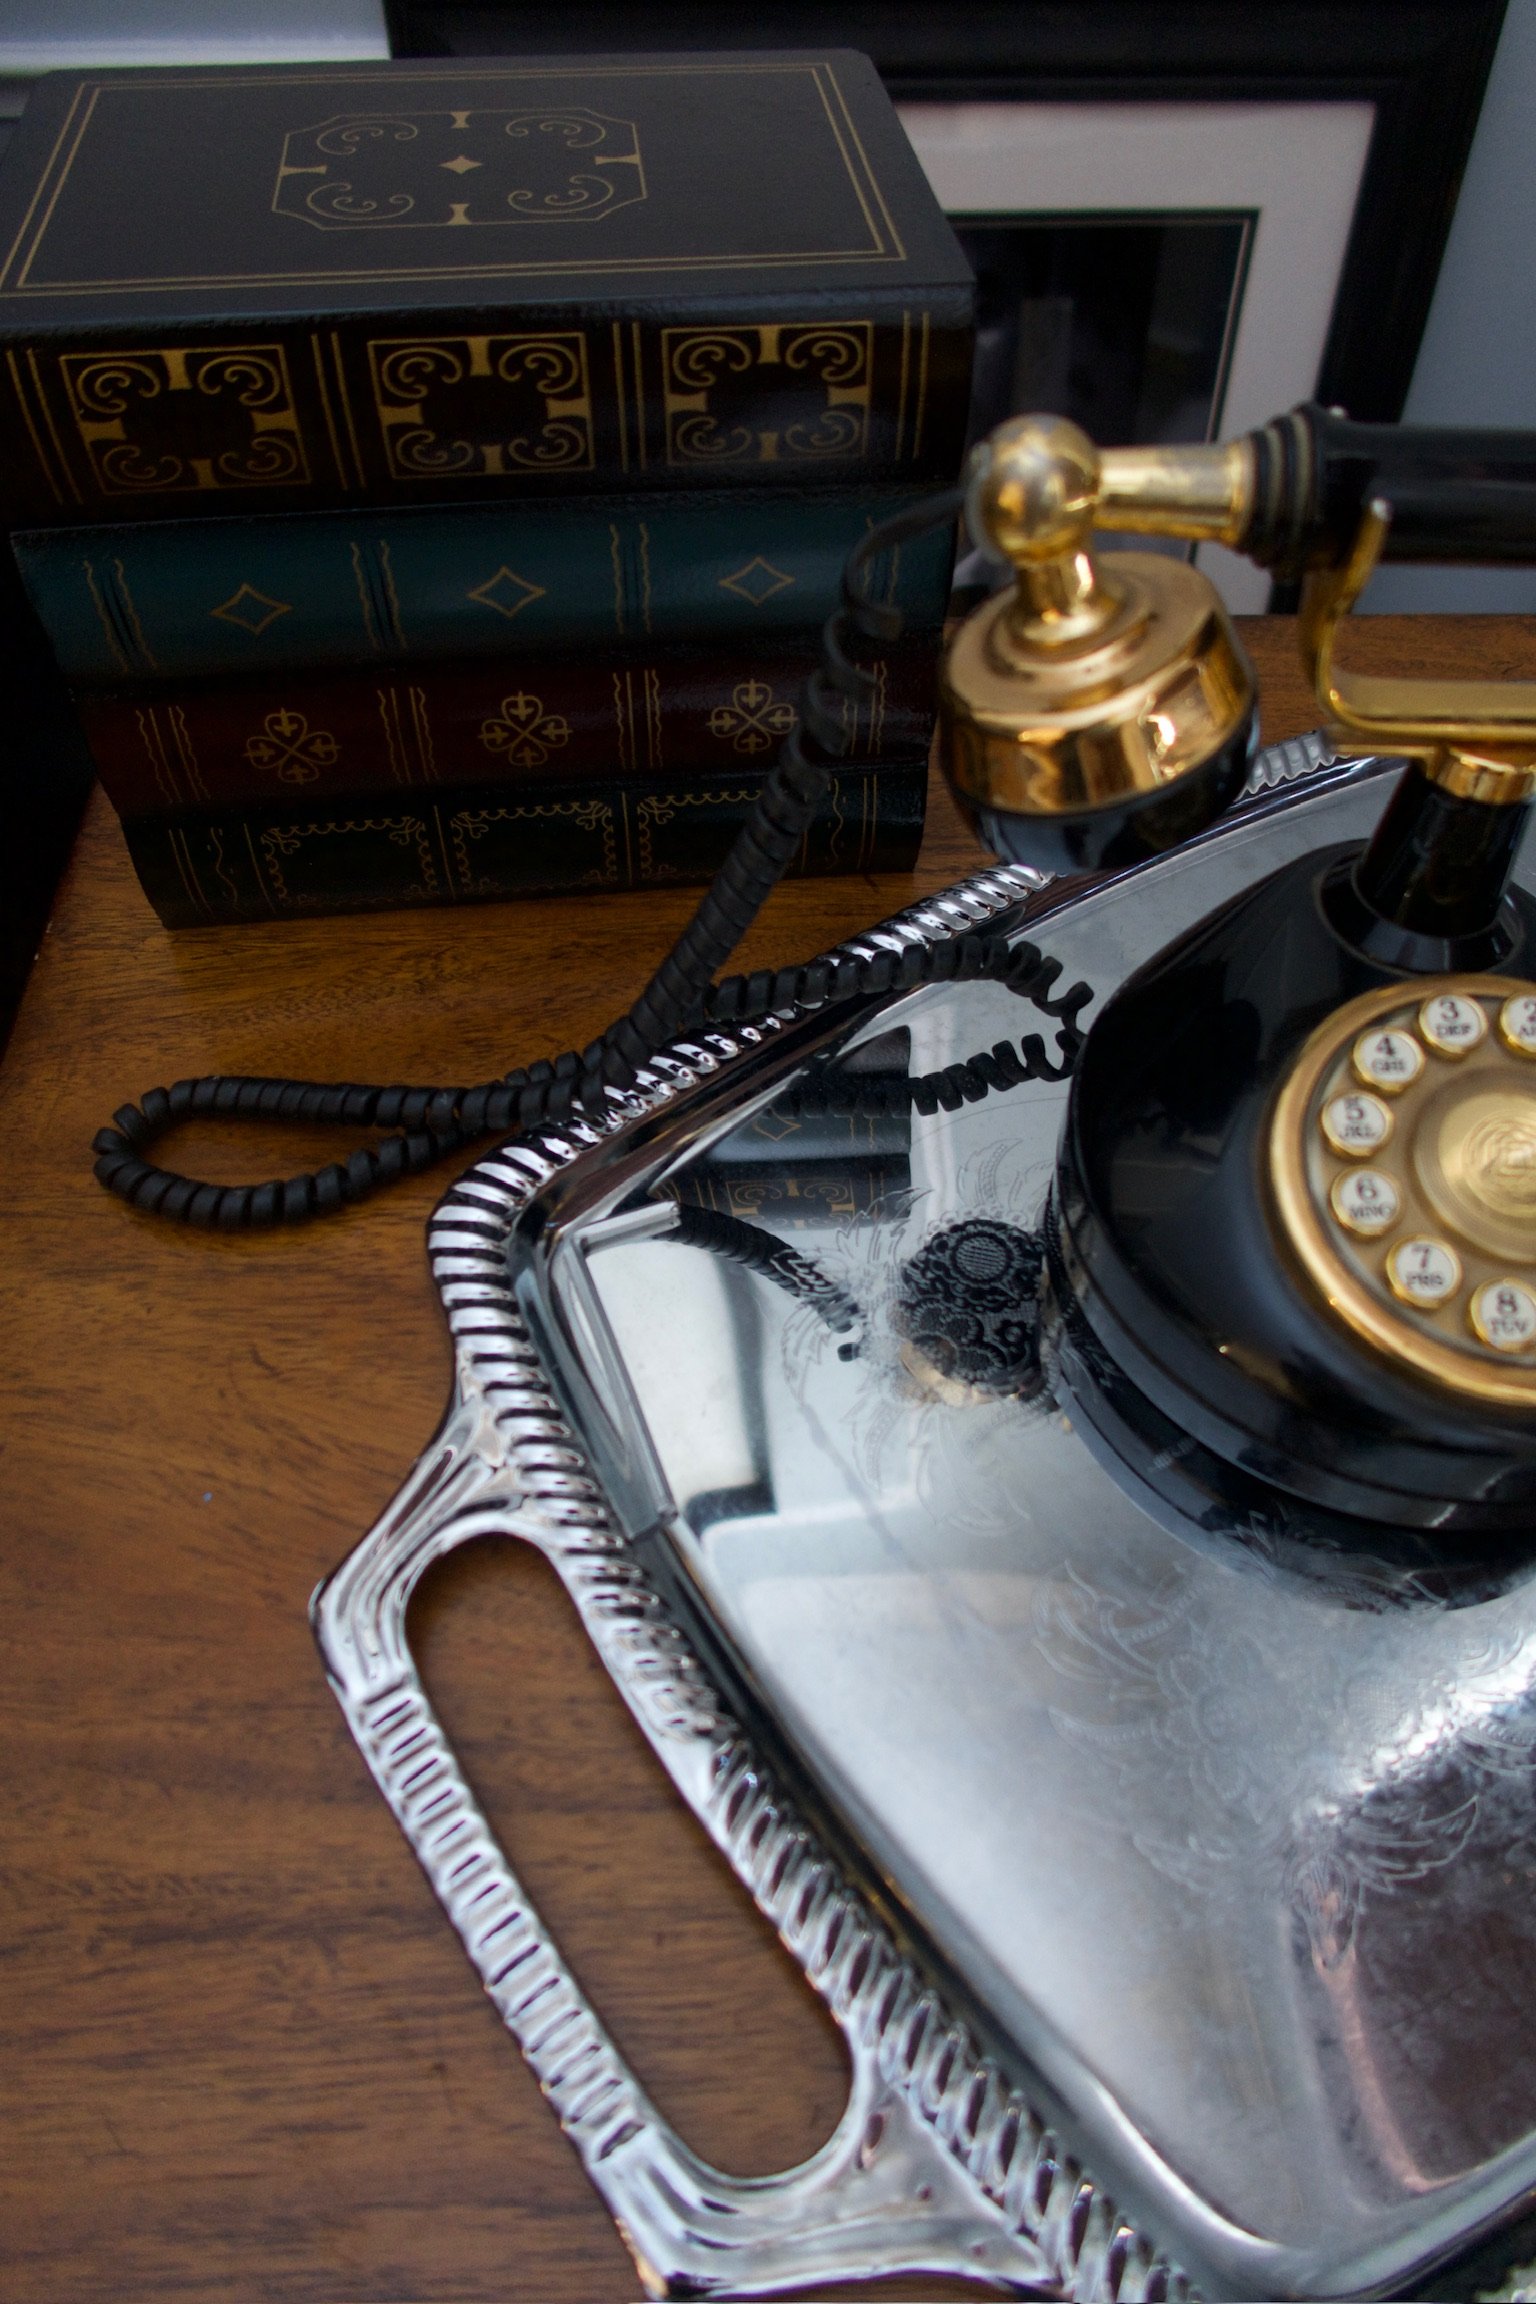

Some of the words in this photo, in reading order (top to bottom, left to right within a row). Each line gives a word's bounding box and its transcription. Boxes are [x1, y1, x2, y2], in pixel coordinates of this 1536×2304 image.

[1439, 997, 1459, 1021] 3
[1376, 1035, 1395, 1056] 4
[1344, 1097, 1364, 1121] 5
[1356, 1176, 1377, 1201] 6
[1411, 1244, 1430, 1269] 7
[1497, 1289, 1518, 1314] 8
